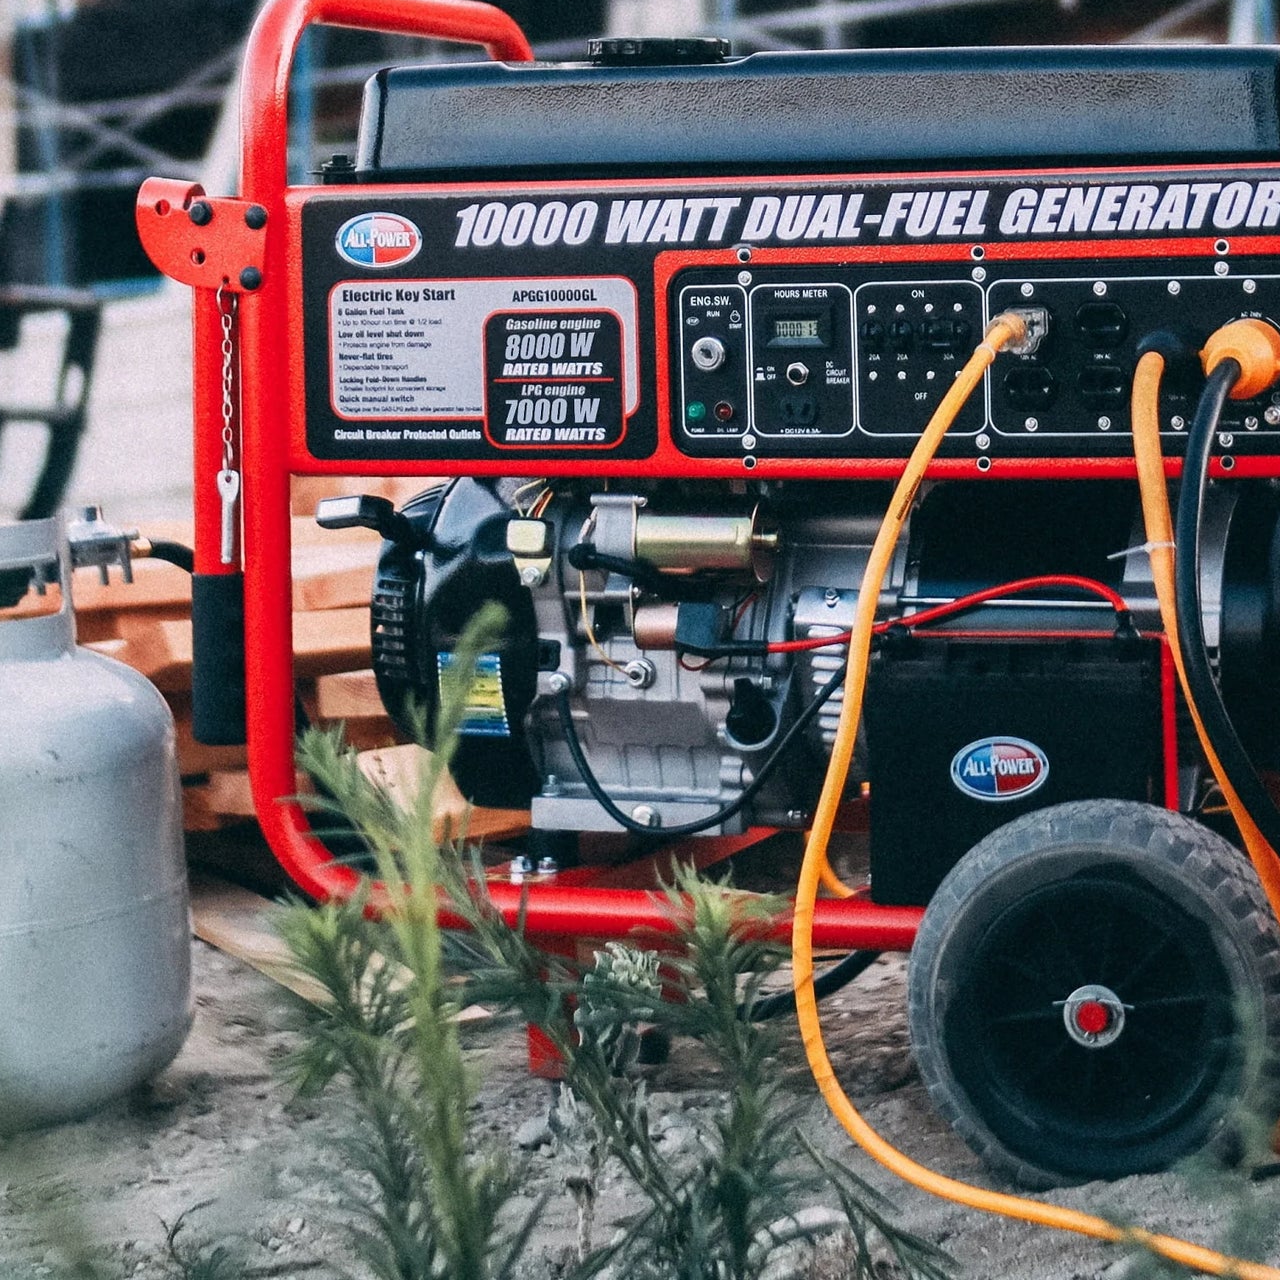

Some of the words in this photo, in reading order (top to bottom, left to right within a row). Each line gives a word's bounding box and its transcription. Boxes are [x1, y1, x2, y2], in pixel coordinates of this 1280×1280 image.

[454, 200, 599, 247] 10000
[605, 197, 742, 245] WATT
[741, 189, 990, 241] DUAL-FUEL
[344, 228, 411, 248] ALL-POWER
[342, 288, 393, 302] Electric
[395, 288, 420, 302] Key
[423, 288, 456, 302] Start
[512, 289, 598, 302] APGG10000GL
[774, 289, 800, 299] HOURS
[802, 288, 828, 298] METER
[911, 289, 925, 299] ON
[690, 295, 732, 306] ENG.SW.
[345, 307, 368, 316] Gallon
[369, 307, 385, 316] Fuel
[387, 307, 405, 316] Tank
[505, 318, 558, 331] Gasoline
[559, 317, 601, 331] engine
[338, 330, 353, 338] Low
[356, 330, 365, 338] oil
[367, 330, 384, 338] level
[386, 330, 402, 338] shut
[404, 330, 424, 338] down
[505, 332, 566, 360] 8000
[570, 332, 595, 358] W
[502, 362, 549, 376] RATED
[551, 362, 603, 376] WATTS
[521, 384, 542, 396] LPG
[544, 383, 586, 397] engine
[914, 392, 928, 401] OFF
[339, 394, 360, 402] Quick
[362, 394, 388, 402] manual
[390, 394, 415, 402] switch
[505, 399, 568, 424] 7000
[573, 398, 601, 424] W
[334, 428, 364, 440] Circuit
[366, 428, 401, 440] Breaker
[403, 428, 447, 440] Protected
[449, 428, 482, 440] Outlets
[505, 428, 551, 441] RATED
[554, 428, 607, 441] WATTS
[962, 754, 1035, 776] ALL-POWER
